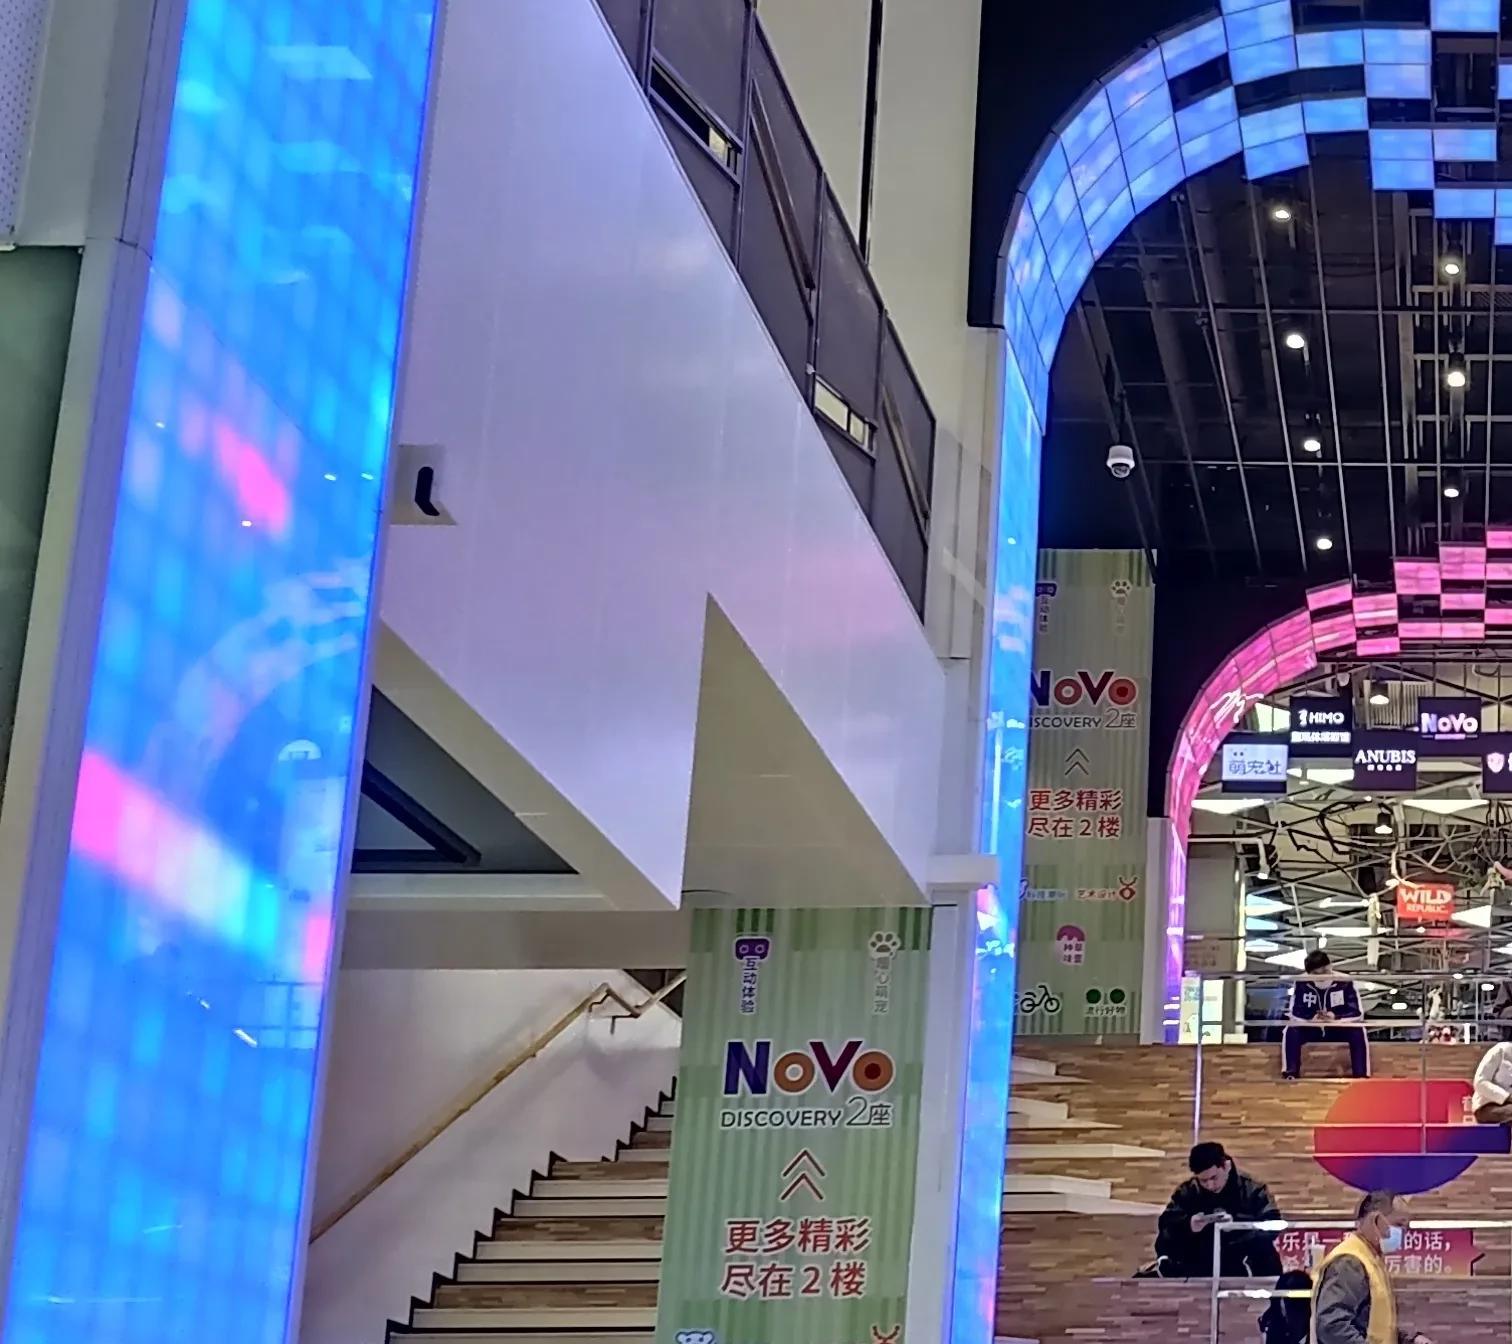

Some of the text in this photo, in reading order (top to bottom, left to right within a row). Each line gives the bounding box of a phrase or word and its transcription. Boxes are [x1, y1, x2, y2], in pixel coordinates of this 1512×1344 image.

[1029, 716, 1102, 728] ISCOVERY
[1309, 711, 1345, 724] HIMO
[1420, 712, 1479, 733] NoVo
[1354, 749, 1416, 764] ANUBIS
[1029, 789, 1122, 811] 更多精彩
[1401, 887, 1452, 904] WILD
[723, 1040, 895, 1095] NoVo
[721, 1096, 892, 1128] DISCOVERY 2座
[725, 1218, 870, 1253] 更多精彩
